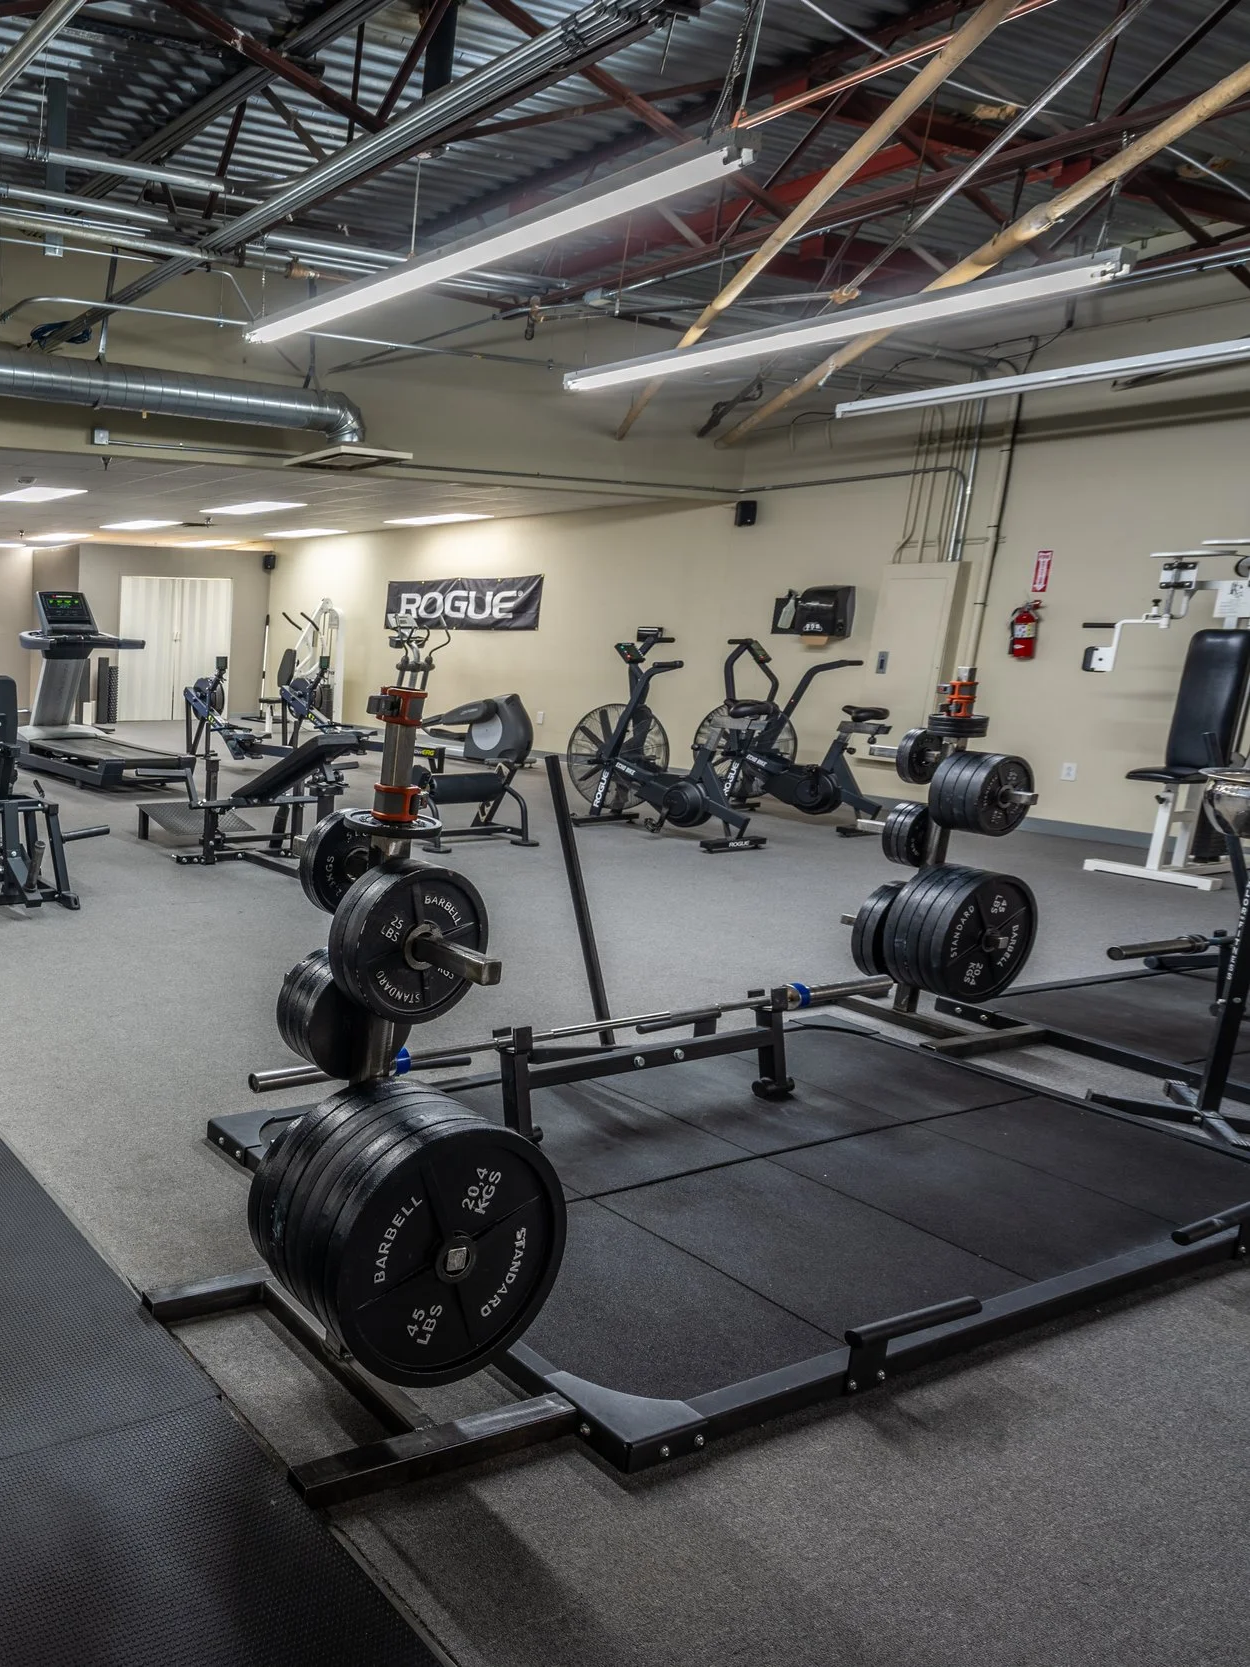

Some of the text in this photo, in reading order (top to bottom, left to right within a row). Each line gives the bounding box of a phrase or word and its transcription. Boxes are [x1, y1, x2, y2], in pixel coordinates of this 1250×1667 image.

[400, 590, 518, 620] ROGUE
[593, 769, 610, 808] ROGUE
[424, 895, 462, 926] BARBELL
[990, 895, 1004, 914] LBS
[380, 924, 400, 942] LBS
[390, 914, 404, 930] 25
[950, 905, 975, 958] STANDARD
[996, 924, 1020, 967] BARBELL
[375, 970, 421, 1004] STANDARD
[963, 962, 977, 983] KGS
[474, 1171, 502, 1215] KGS
[373, 1196, 423, 1283] BARBELL
[480, 1227, 527, 1317] STANDARD
[406, 1308, 426, 1337] 45
[416, 1304, 443, 1345] LBS
